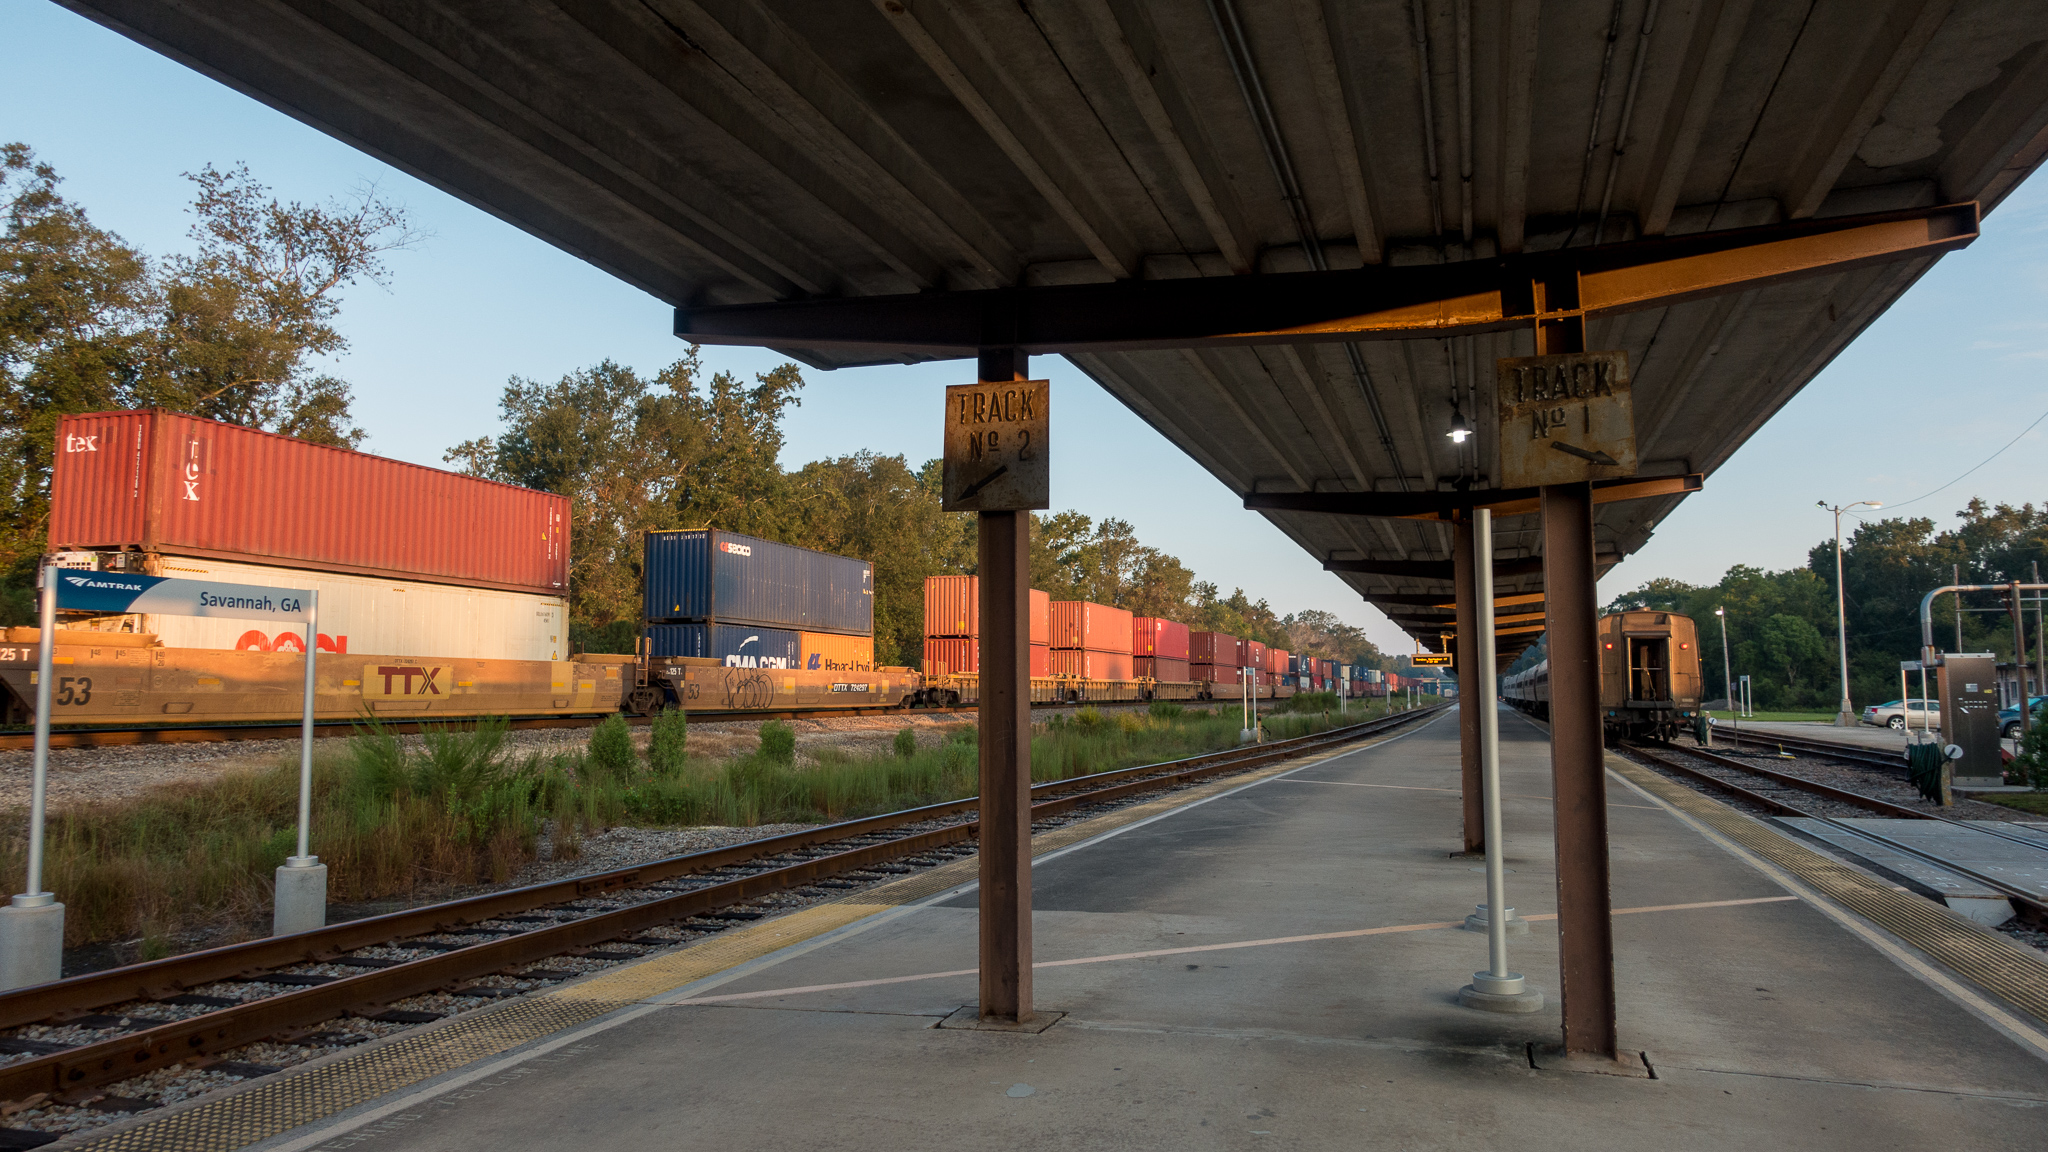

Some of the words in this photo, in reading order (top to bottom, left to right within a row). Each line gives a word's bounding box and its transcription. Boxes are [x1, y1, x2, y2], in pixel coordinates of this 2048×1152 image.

[1513, 361, 1613, 402] TRACK
[957, 389, 1036, 424] TRACK
[66, 433, 98, 453] tex
[1018, 430, 1030, 461] 2
[87, 580, 142, 591] AMTRAK
[200, 591, 276, 613] Savannah,
[281, 598, 302, 612] GA
[22, 648, 31, 661] T
[57, 676, 92, 706] 53
[378, 666, 441, 695] TTX
[688, 684, 700, 700] 53
